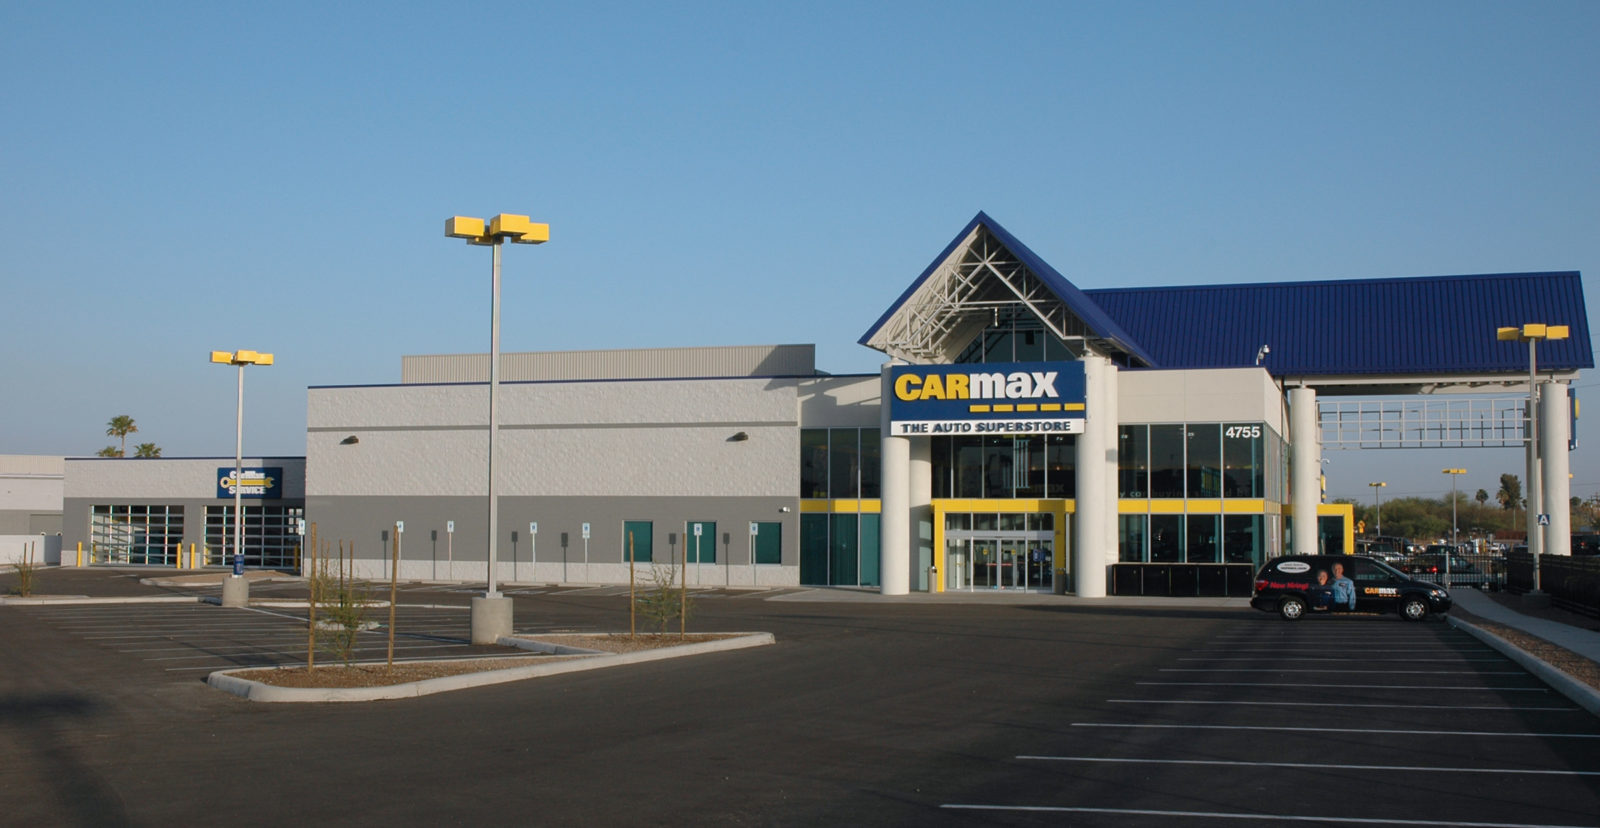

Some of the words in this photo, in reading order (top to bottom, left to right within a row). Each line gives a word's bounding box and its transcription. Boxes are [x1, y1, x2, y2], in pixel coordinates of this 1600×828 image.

[901, 423, 929, 434] THE
[933, 422, 972, 433] AUTO
[975, 421, 1071, 433] SUPERSTORE
[1225, 426, 1261, 438] 4755
[1539, 514, 1549, 525] A
